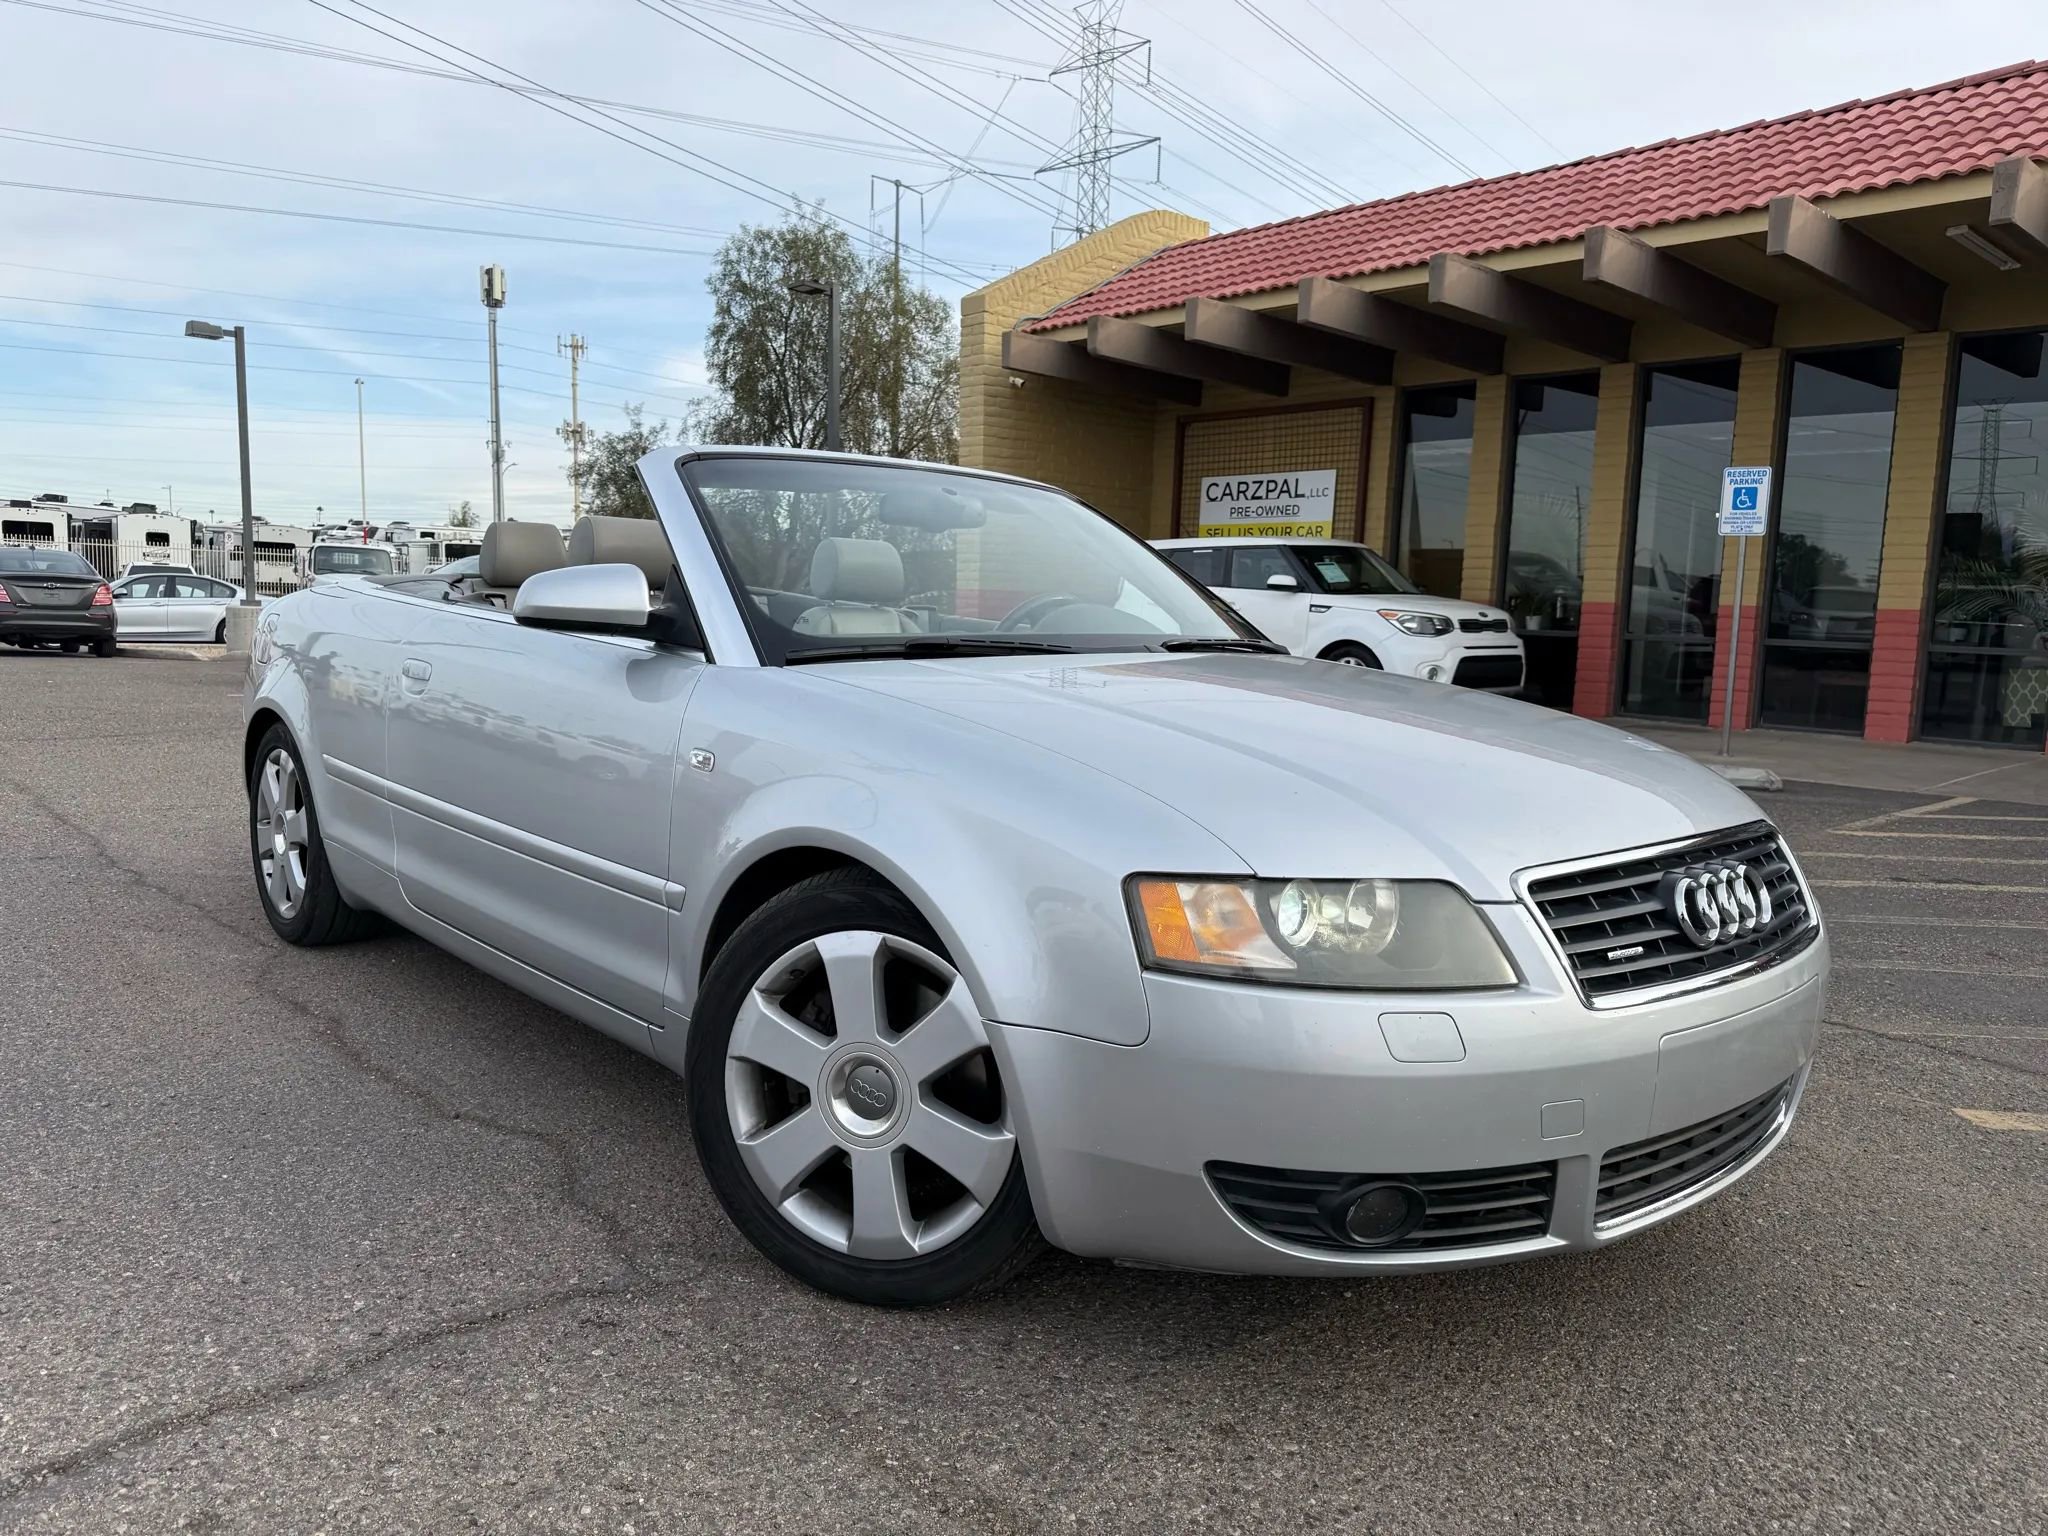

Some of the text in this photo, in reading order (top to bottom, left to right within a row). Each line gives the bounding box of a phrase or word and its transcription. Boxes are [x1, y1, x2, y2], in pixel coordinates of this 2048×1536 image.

[1727, 470, 1768, 478] RESERVED
[1729, 478, 1764, 486] PARKING
[1229, 504, 1301, 517] PRE-OWNED
[1238, 527, 1254, 537] US
[1258, 526, 1292, 537] YOUR
[1296, 525, 1324, 537] CAR
